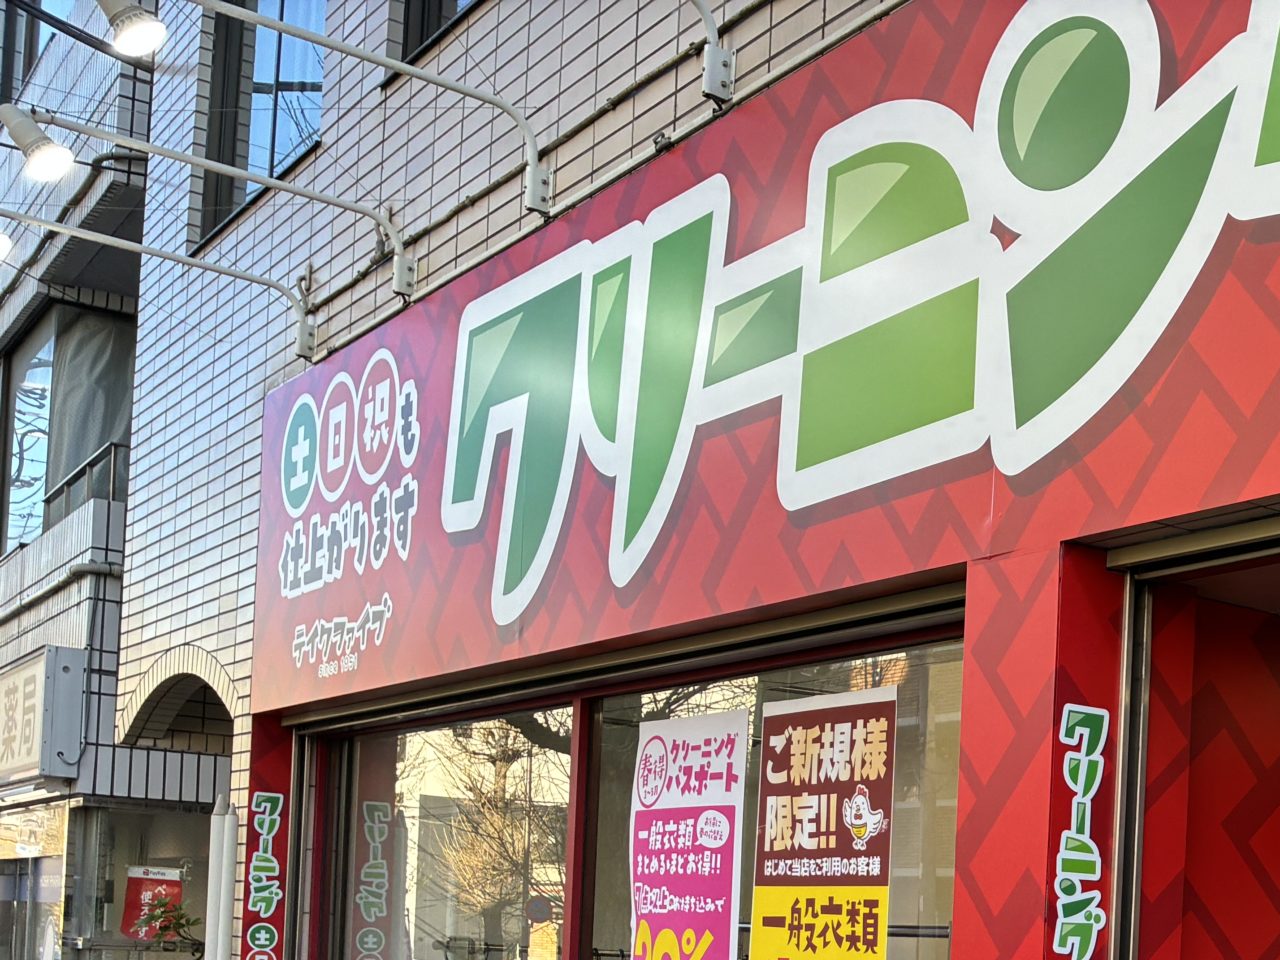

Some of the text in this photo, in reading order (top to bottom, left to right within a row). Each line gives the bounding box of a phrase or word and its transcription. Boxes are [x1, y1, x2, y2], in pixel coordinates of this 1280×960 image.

[281, 347, 420, 519] 土日祝も
[278, 472, 418, 599] 仕上がります
[292, 592, 392, 669] テイクファイブ
[318, 652, 358, 678] since 1951
[1, 674, 37, 764] 薬局
[670, 732, 738, 765] クリーニング
[665, 760, 738, 797] パスポート
[766, 718, 889, 786] ご新規様
[638, 818, 695, 850] 一般衣類
[764, 793, 838, 852] 限定!!
[248, 791, 284, 918] クリーニング
[637, 850, 721, 877] まとめるほどお得!!
[764, 855, 881, 877] はじめて当店をご利用のお客様
[762, 896, 880, 955] 一般衣類
